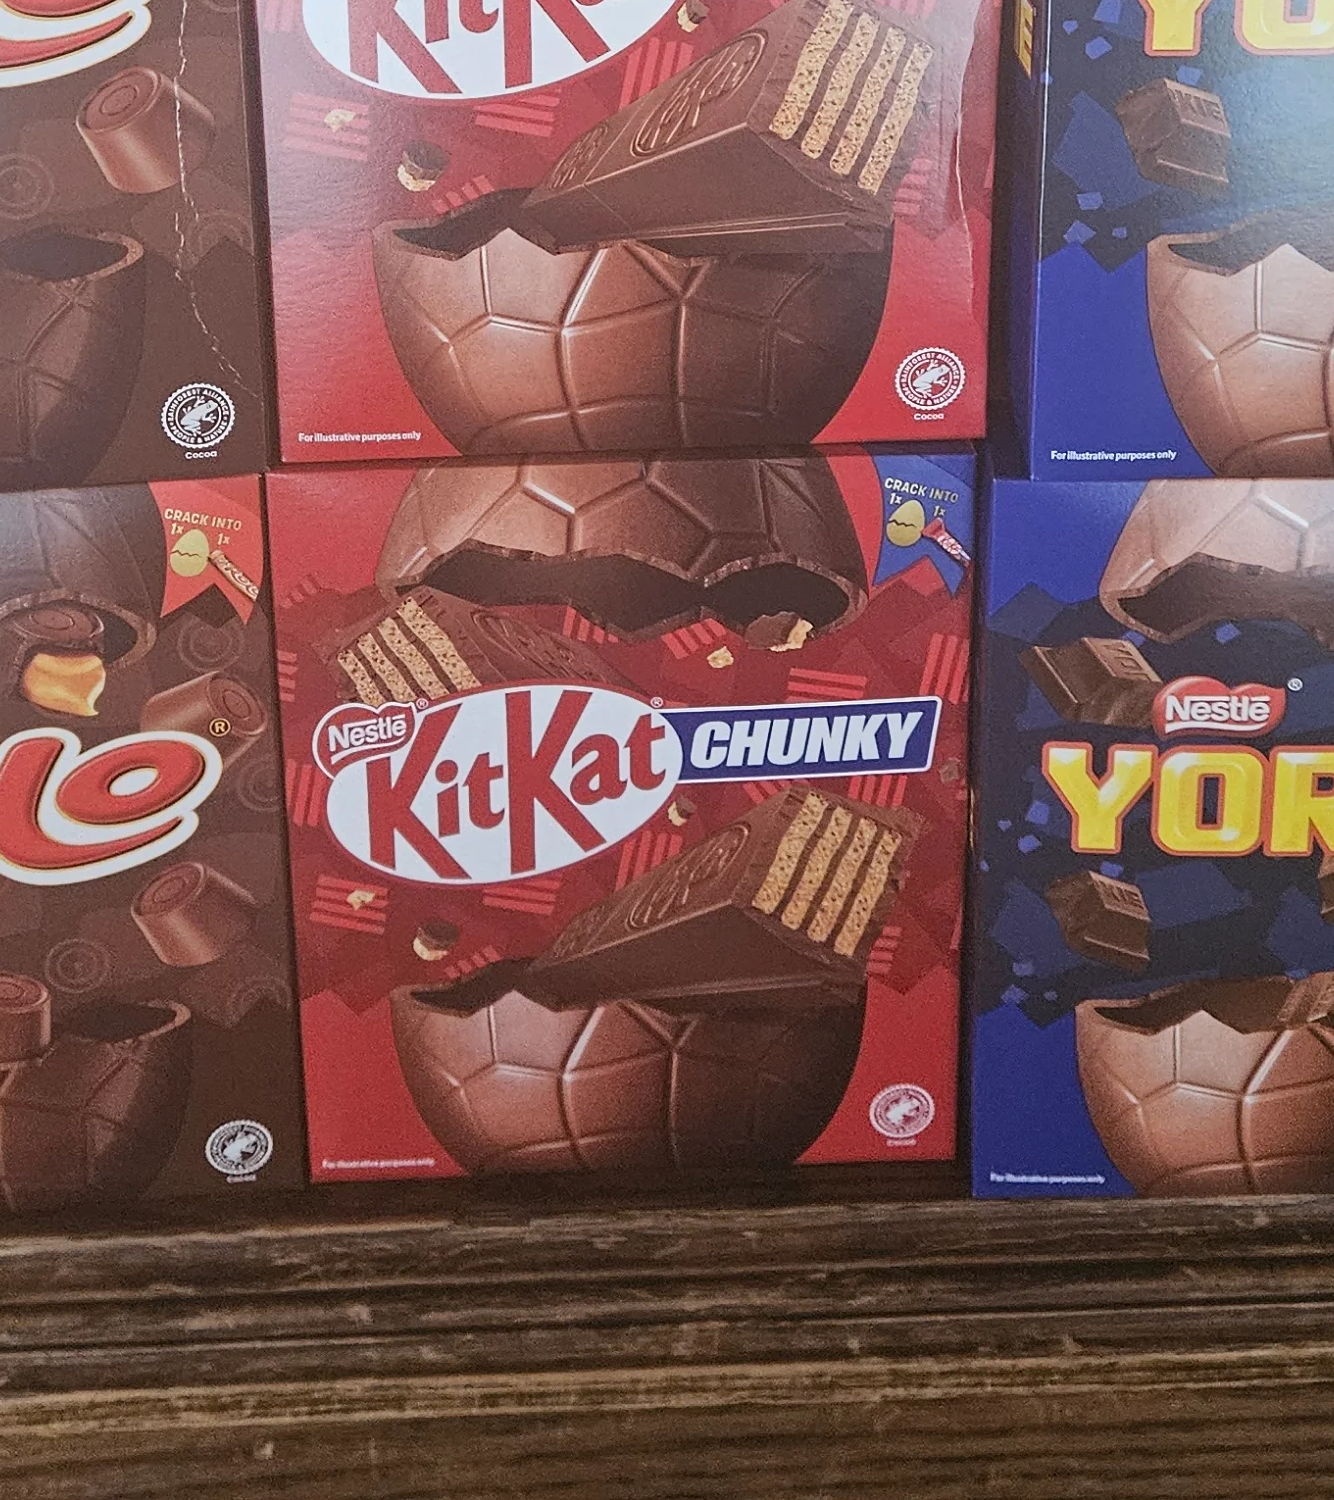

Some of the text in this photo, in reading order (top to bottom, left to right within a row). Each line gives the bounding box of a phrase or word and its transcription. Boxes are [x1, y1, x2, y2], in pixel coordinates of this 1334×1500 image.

[901, 354, 960, 383] RAINFOREST ALLIANCE
[903, 383, 959, 405] PEOPLE NATURE
[168, 389, 229, 421] RAINFOREST ALLIANCE
[913, 412, 944, 421] Cocoa
[170, 420, 228, 443] PEOPLE NATURE
[298, 431, 421, 443] For illustrative purposes only
[185, 451, 218, 460] Cocoa
[1050, 449, 1177, 462] For illustrative purposes only
[884, 477, 959, 505] CRACK INTO
[889, 491, 903, 506] 1x
[933, 504, 947, 518] 1x
[164, 508, 242, 534] CRACK INTO
[170, 522, 185, 537] 1x
[217, 533, 231, 547] 1x
[366, 689, 922, 880] KitKat CHUNKY
